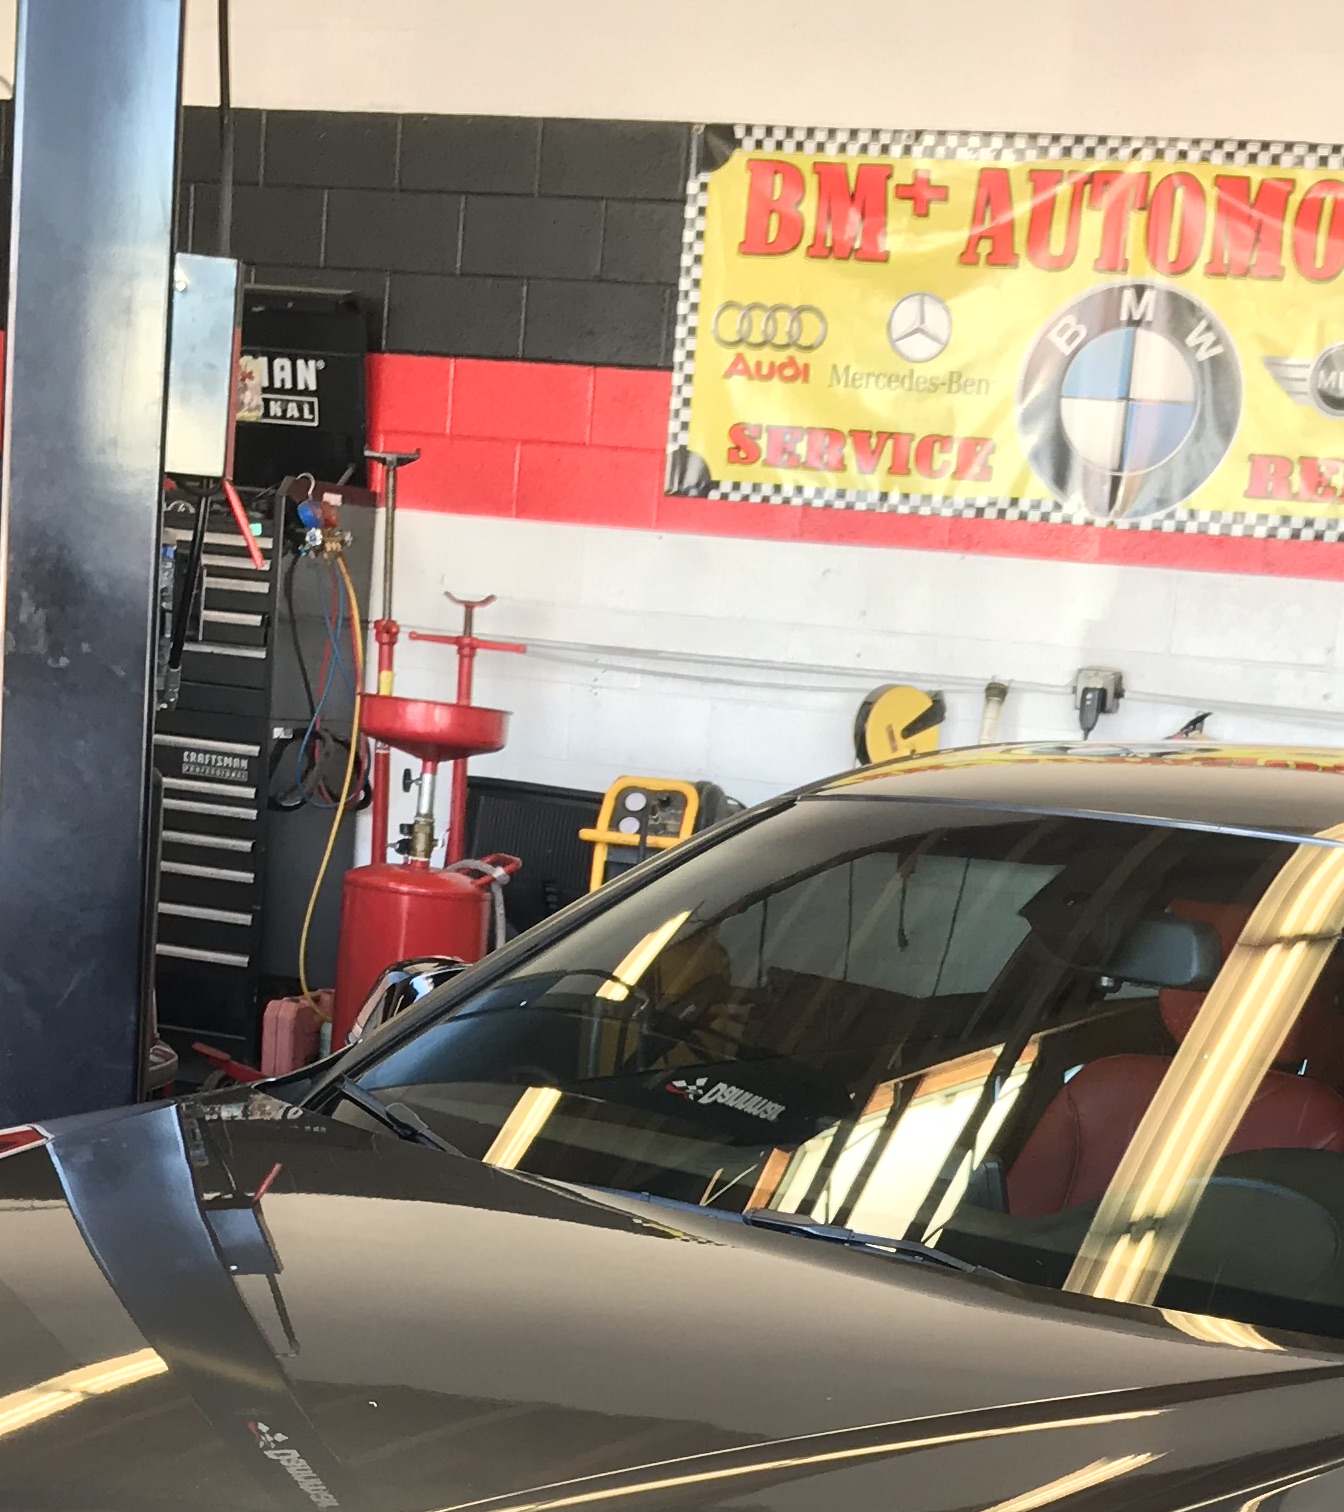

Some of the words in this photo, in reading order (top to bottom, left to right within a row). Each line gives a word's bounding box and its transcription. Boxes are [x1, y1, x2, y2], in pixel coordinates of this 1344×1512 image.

[1046, 288, 1224, 361] BMW
[722, 353, 811, 384] Audi
[827, 364, 996, 396] Mercedes-Ben
[727, 422, 996, 481] SERVICE
[183, 751, 249, 770] CRAFTSMAN
